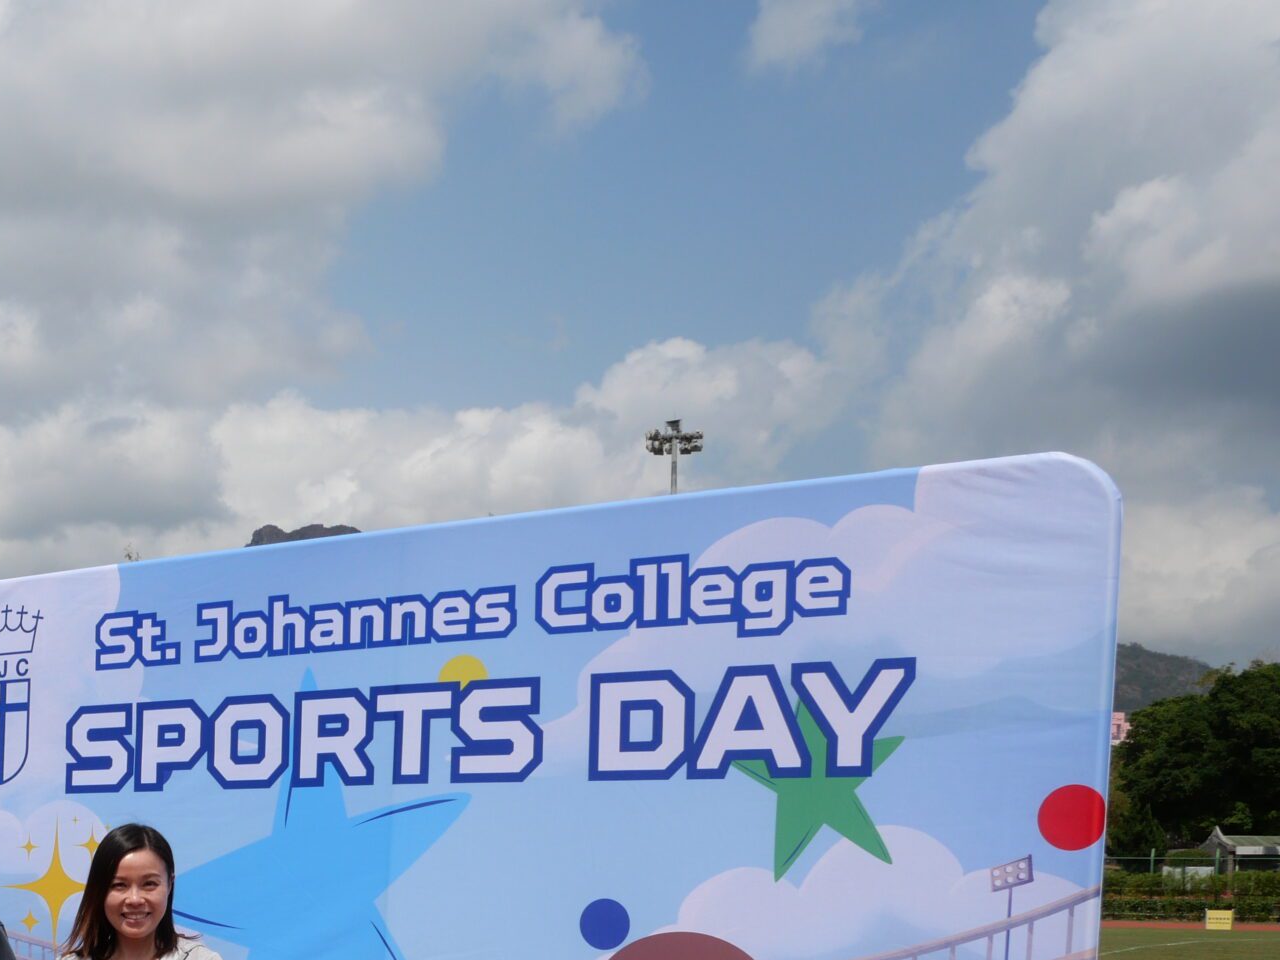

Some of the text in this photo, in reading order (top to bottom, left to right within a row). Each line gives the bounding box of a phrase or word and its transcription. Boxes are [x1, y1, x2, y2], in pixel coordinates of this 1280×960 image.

[96, 554, 851, 670] St. Johannes College
[65, 657, 916, 794] SPORTS DAY
